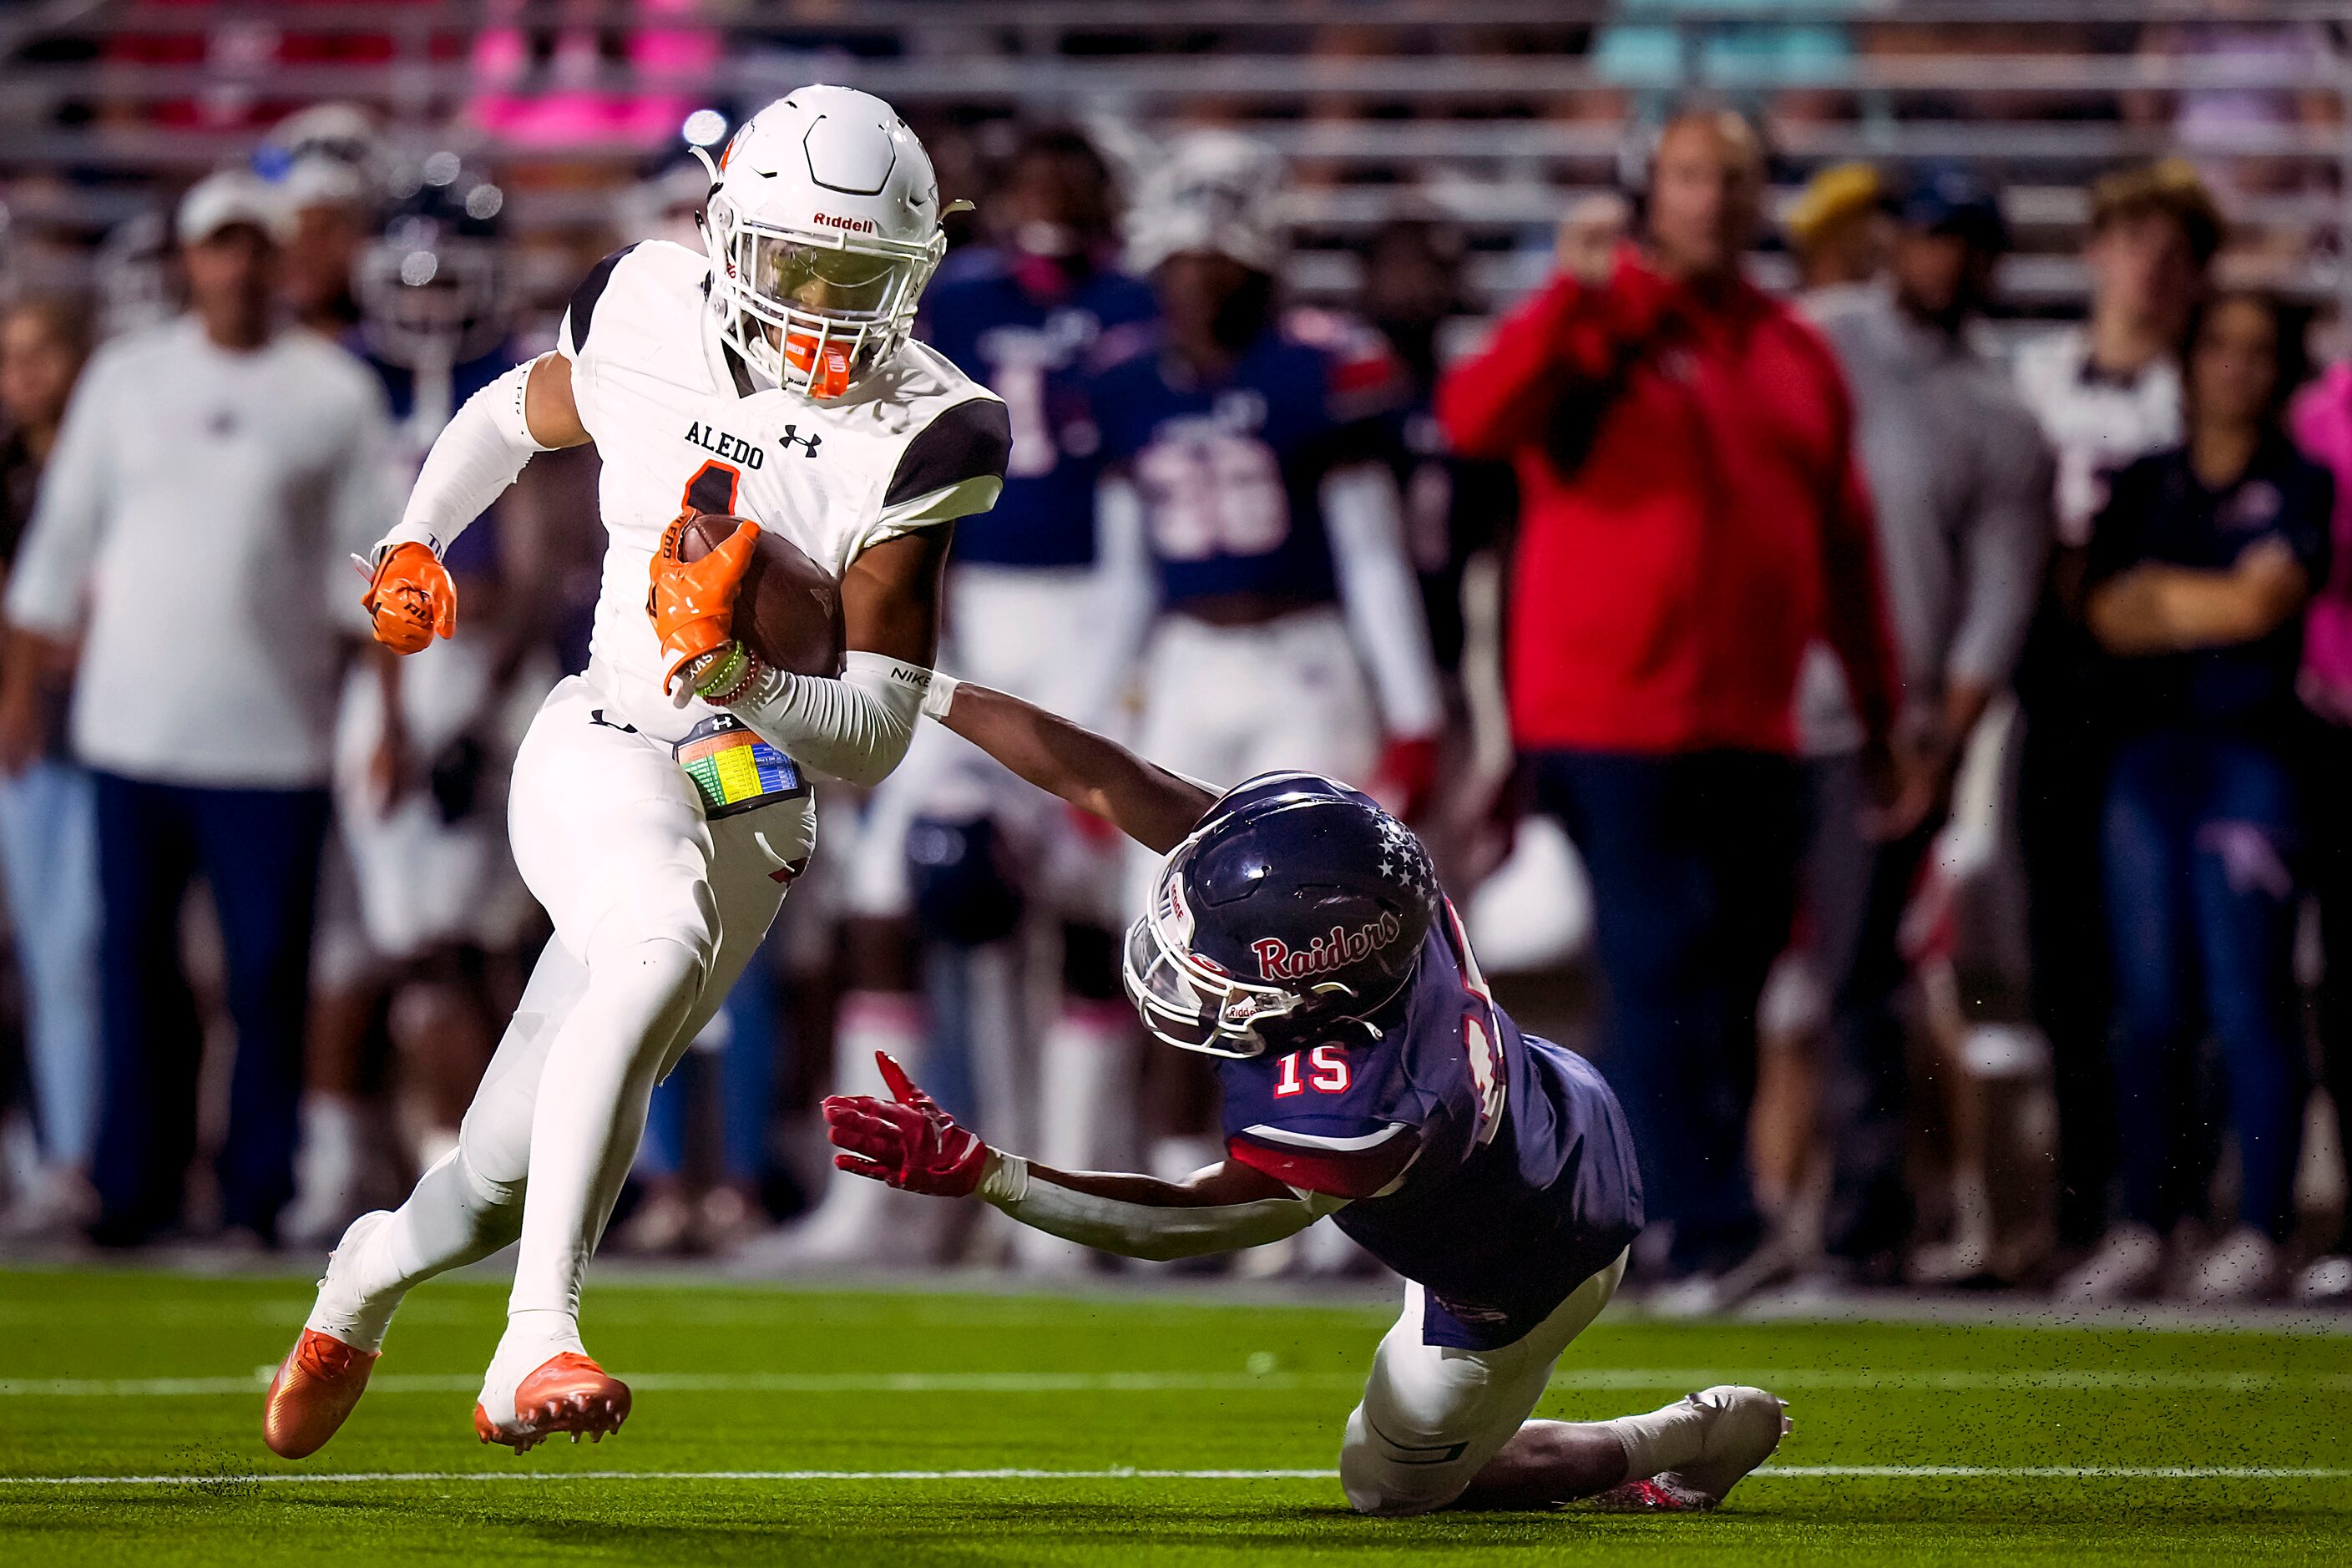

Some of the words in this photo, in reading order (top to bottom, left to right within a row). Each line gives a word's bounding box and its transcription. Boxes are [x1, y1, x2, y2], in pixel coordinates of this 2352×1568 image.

[813, 212, 874, 234] Riddell
[685, 421, 764, 470] ALEDO
[689, 654, 714, 681] XAS
[891, 667, 932, 688] NIKE
[1251, 910, 1399, 981] Raiders
[1273, 1045, 1352, 1099] 15
